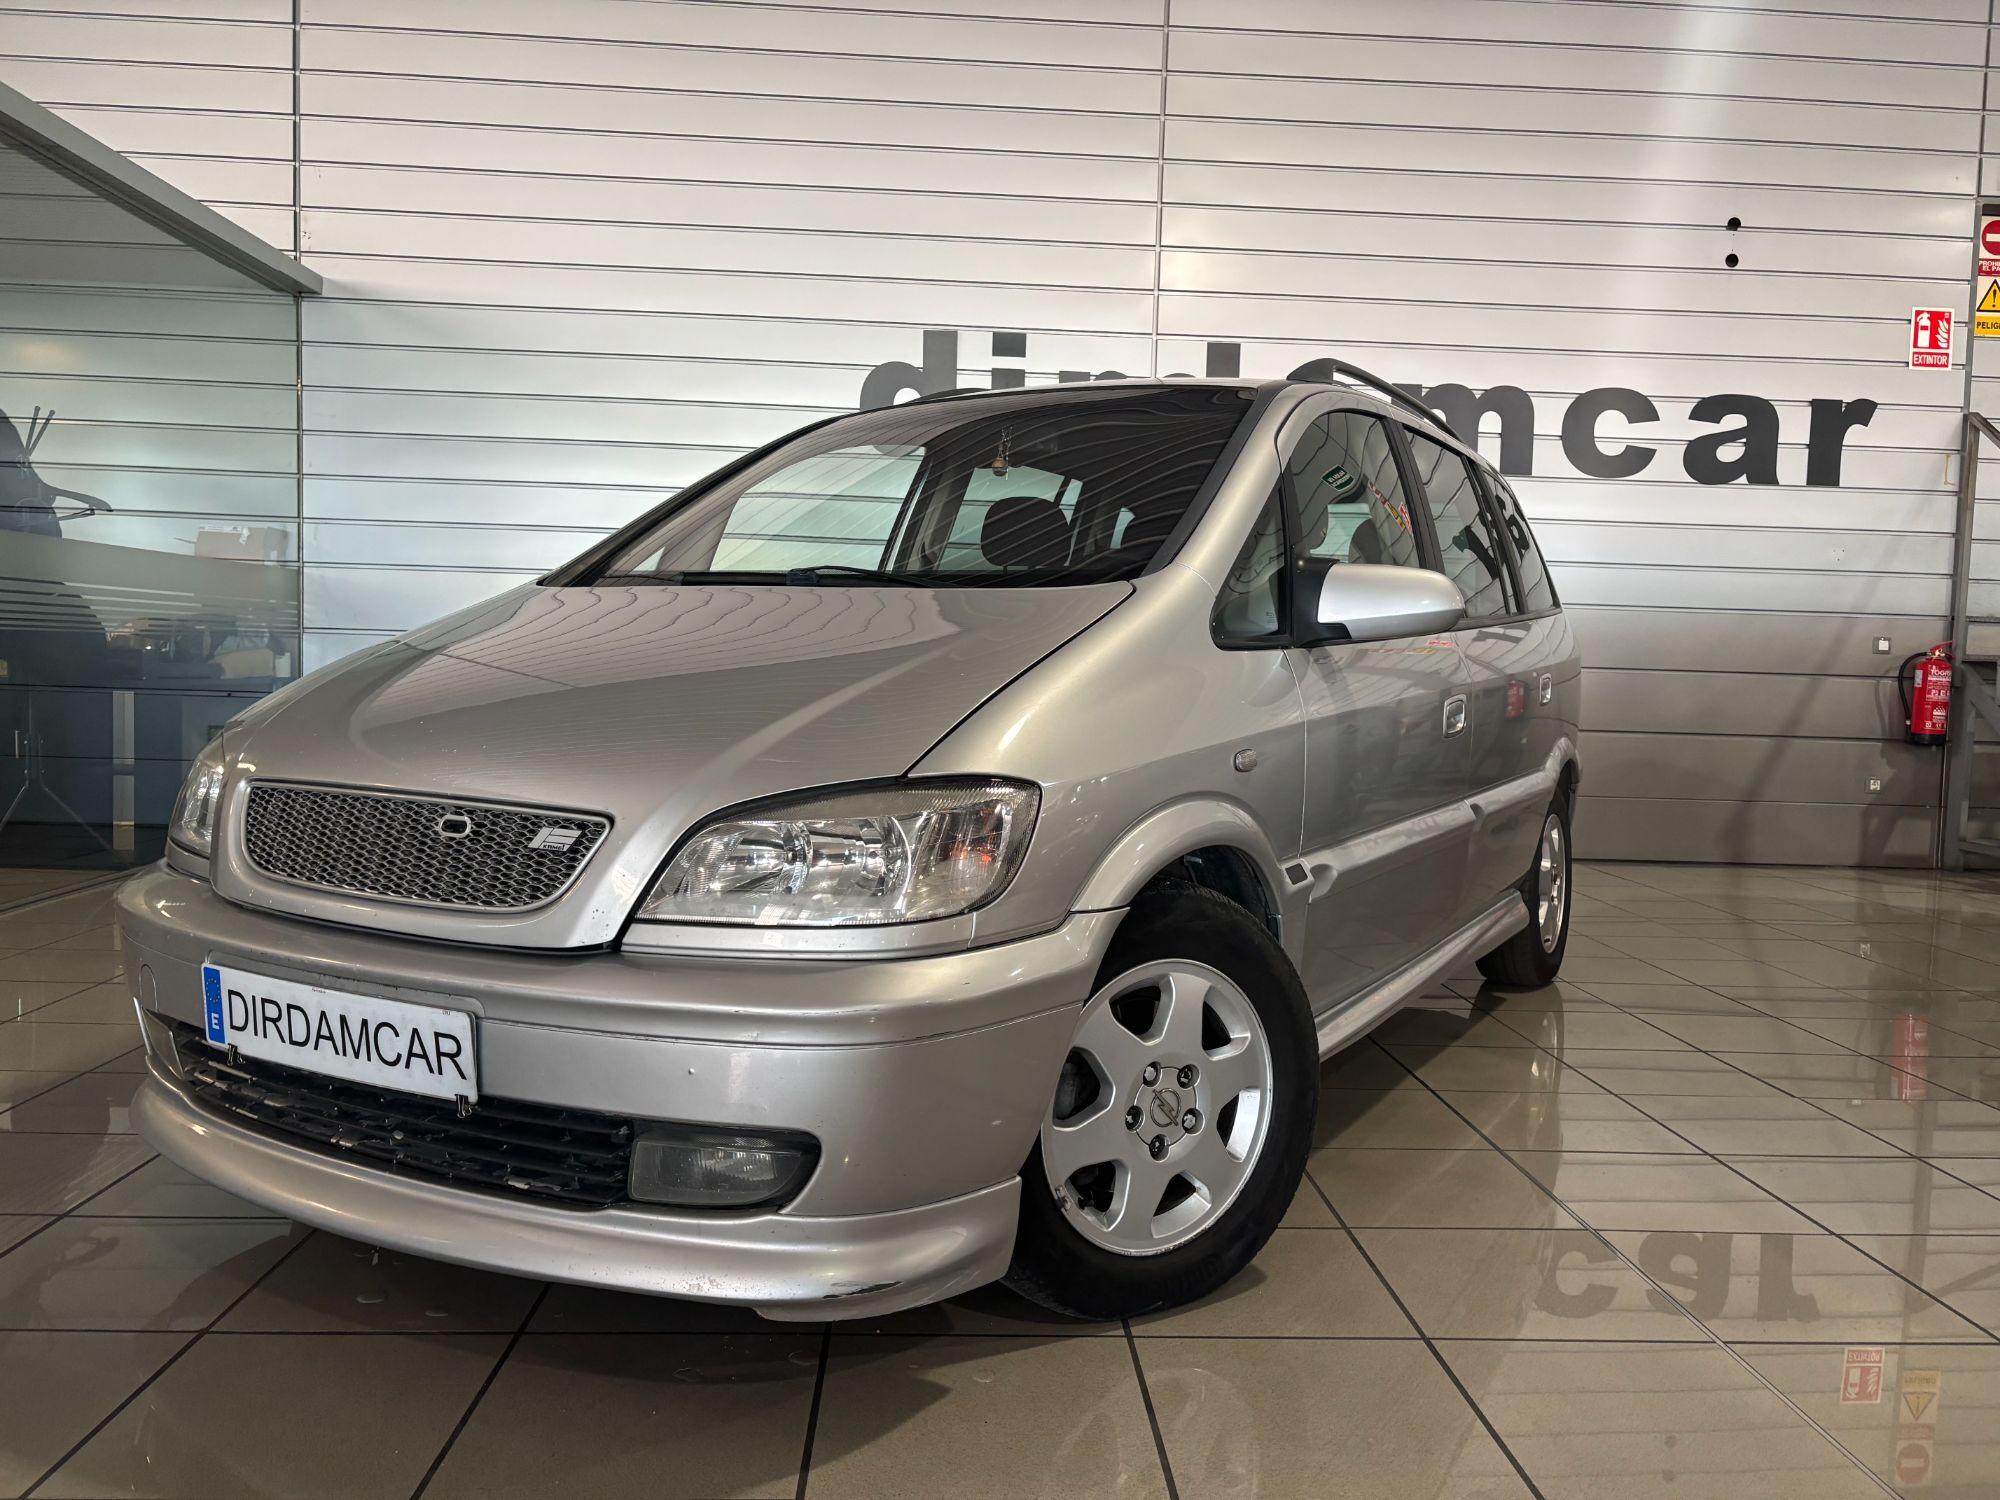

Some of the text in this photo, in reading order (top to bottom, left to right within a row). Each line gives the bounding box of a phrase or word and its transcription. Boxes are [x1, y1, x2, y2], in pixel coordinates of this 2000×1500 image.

[1976, 321, 2000, 330] PELIG
[1913, 354, 1948, 365] EXTINTOR
[860, 330, 1878, 486] dmcar
[211, 989, 467, 1080] E DIRDAMCAR
